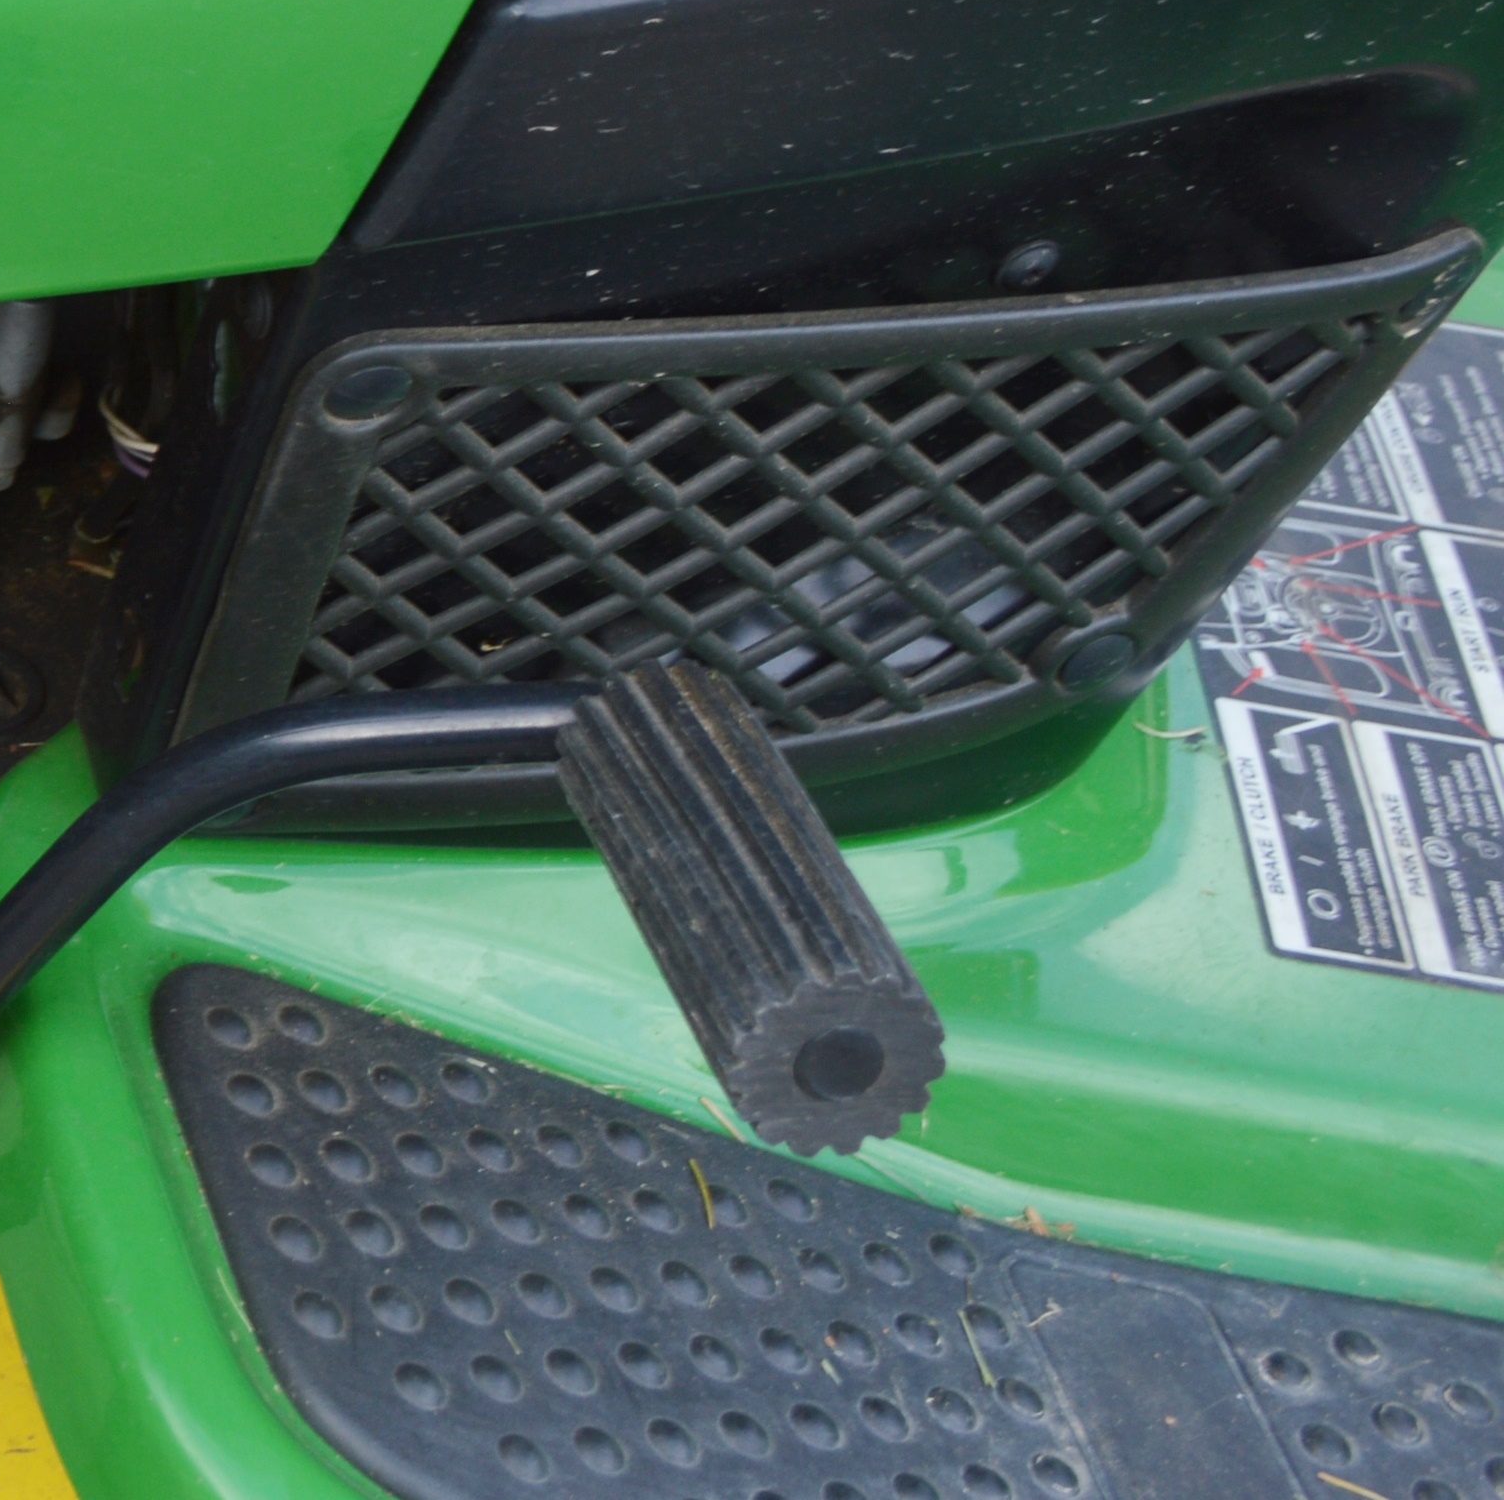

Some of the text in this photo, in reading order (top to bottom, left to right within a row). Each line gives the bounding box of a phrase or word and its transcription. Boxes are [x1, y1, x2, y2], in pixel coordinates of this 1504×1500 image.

[1306, 743, 1328, 768] and
[1236, 755, 1268, 821] CLUTCH
[1315, 767, 1337, 801] brake
[1413, 765, 1442, 806] BRAKE
[1381, 790, 1427, 898] PARK BRAKE
[1257, 837, 1286, 896] BRAKE
[1338, 860, 1365, 895] pedal
[1451, 890, 1479, 934] BRAKE
